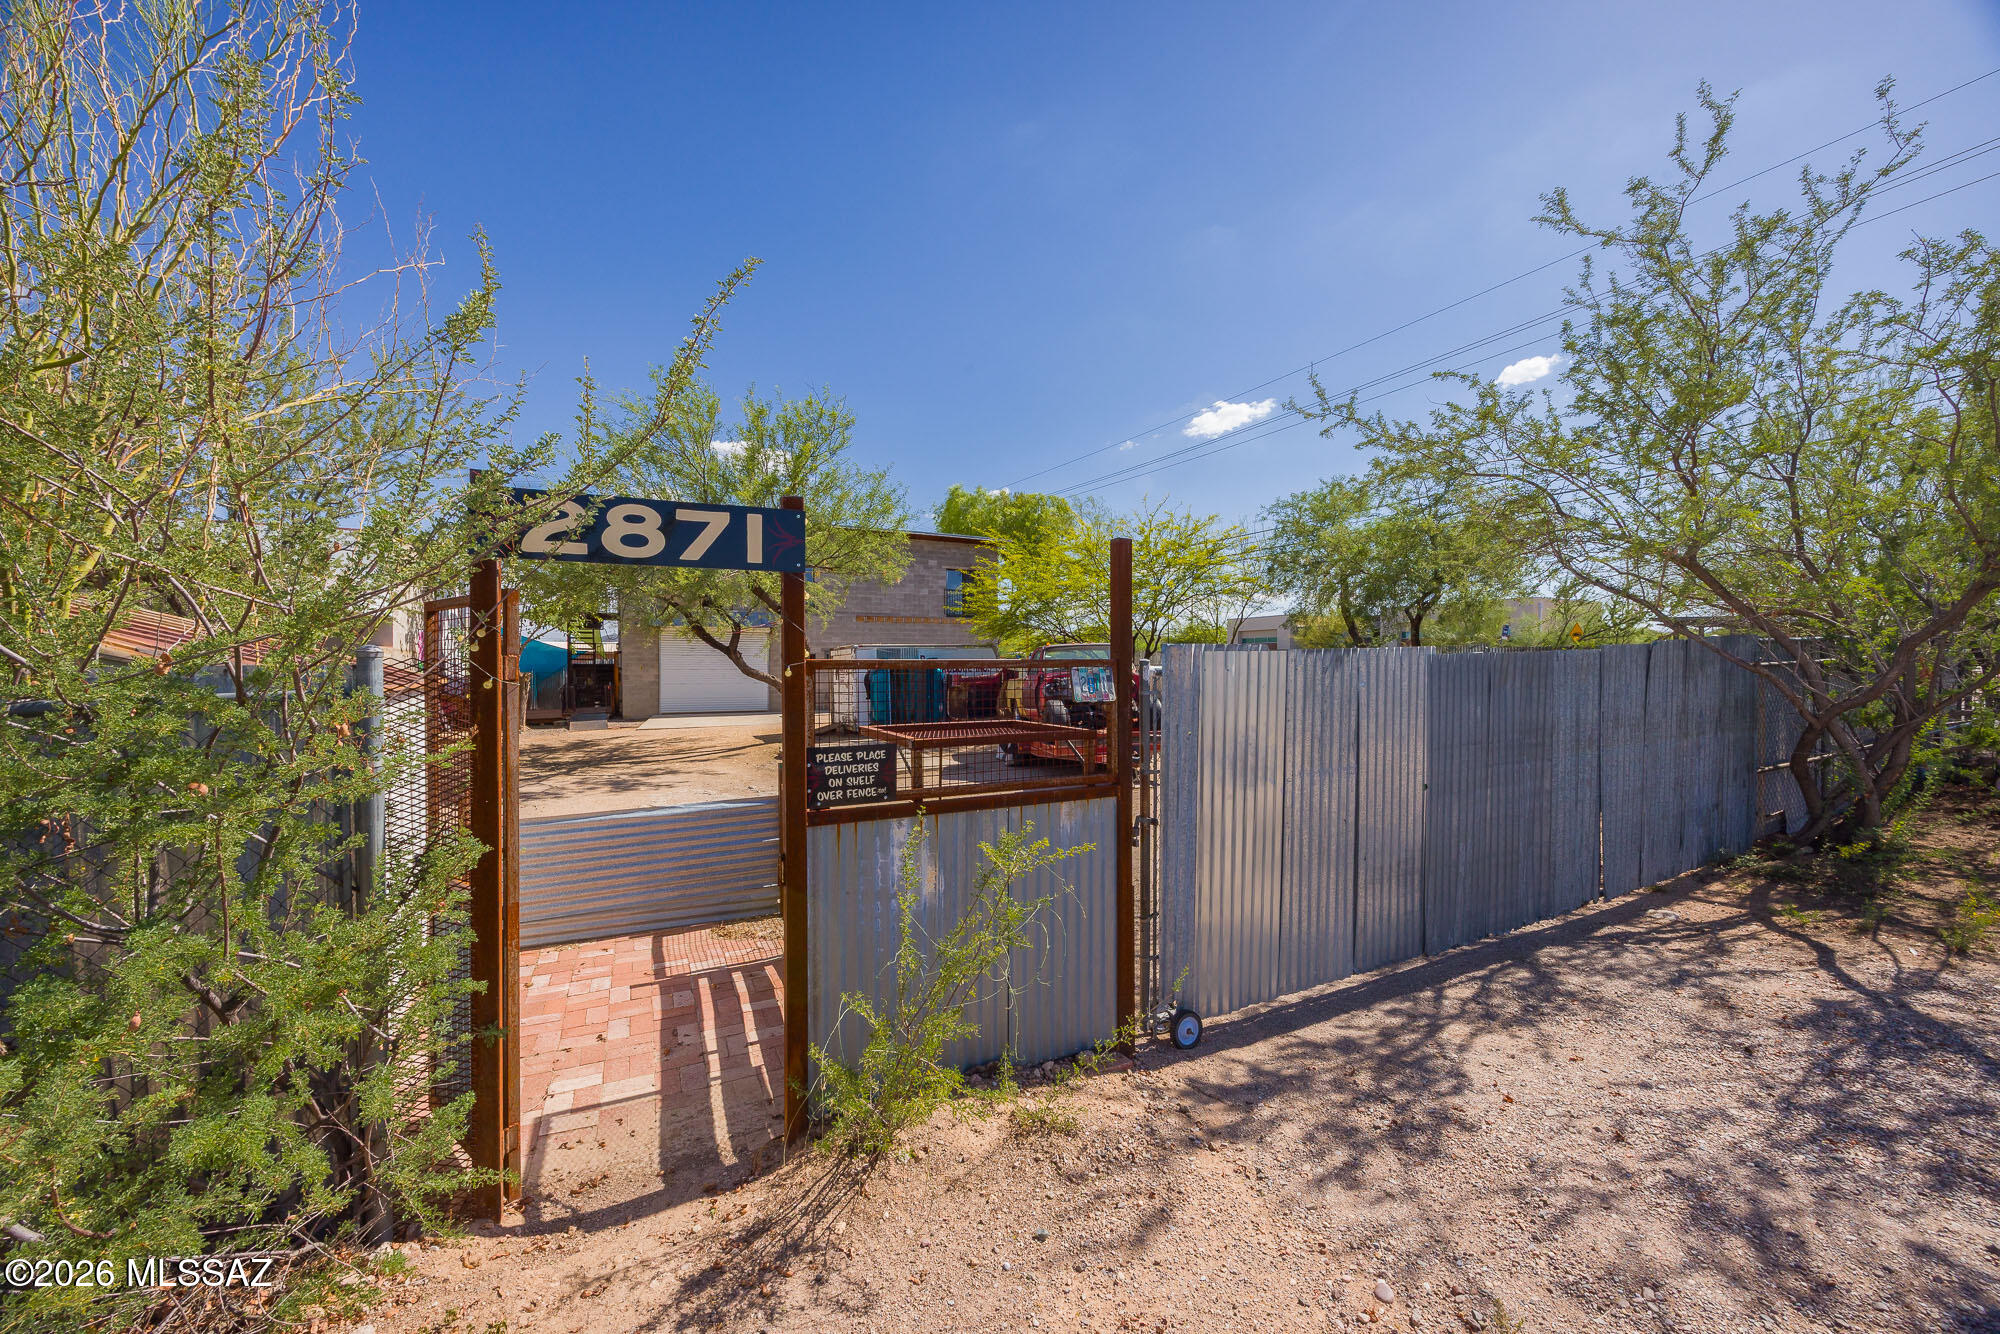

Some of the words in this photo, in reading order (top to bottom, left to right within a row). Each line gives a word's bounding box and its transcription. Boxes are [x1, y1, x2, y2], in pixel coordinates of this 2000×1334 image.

[520, 500, 763, 564] 2871
[816, 752, 853, 763] PLEASE
[856, 750, 886, 760] PLACE
[825, 763, 879, 775] DELIVERIES
[828, 778, 843, 787] ON
[846, 775, 876, 786] SHELF
[817, 790, 843, 801] OVER
[846, 787, 877, 799] FENCE
